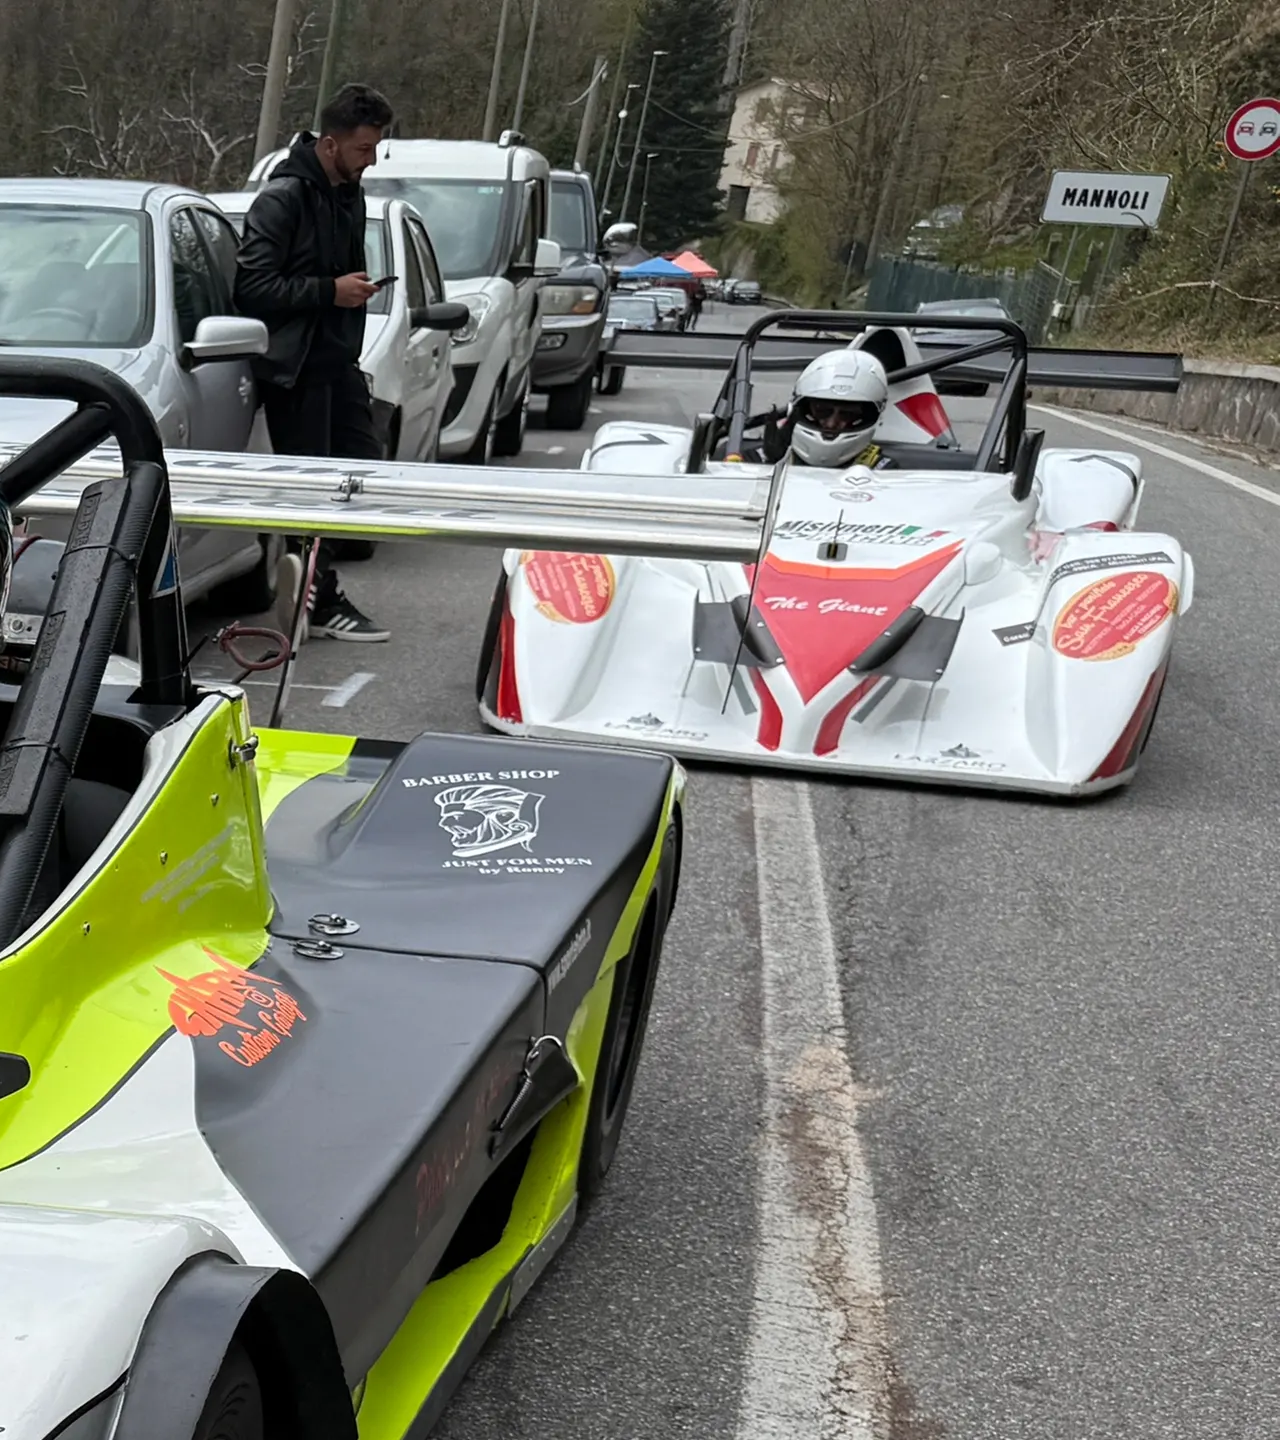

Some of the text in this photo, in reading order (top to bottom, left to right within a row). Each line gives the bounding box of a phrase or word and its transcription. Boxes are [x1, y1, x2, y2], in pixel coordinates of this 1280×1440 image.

[1061, 187, 1150, 210] MANNOLI
[763, 596, 888, 616] The Giant
[401, 769, 561, 788] BARBER SHOP
[441, 857, 594, 869] JUST FOR MEN
[478, 865, 566, 875] by Ronny
[217, 1027, 282, 1068] Custom
